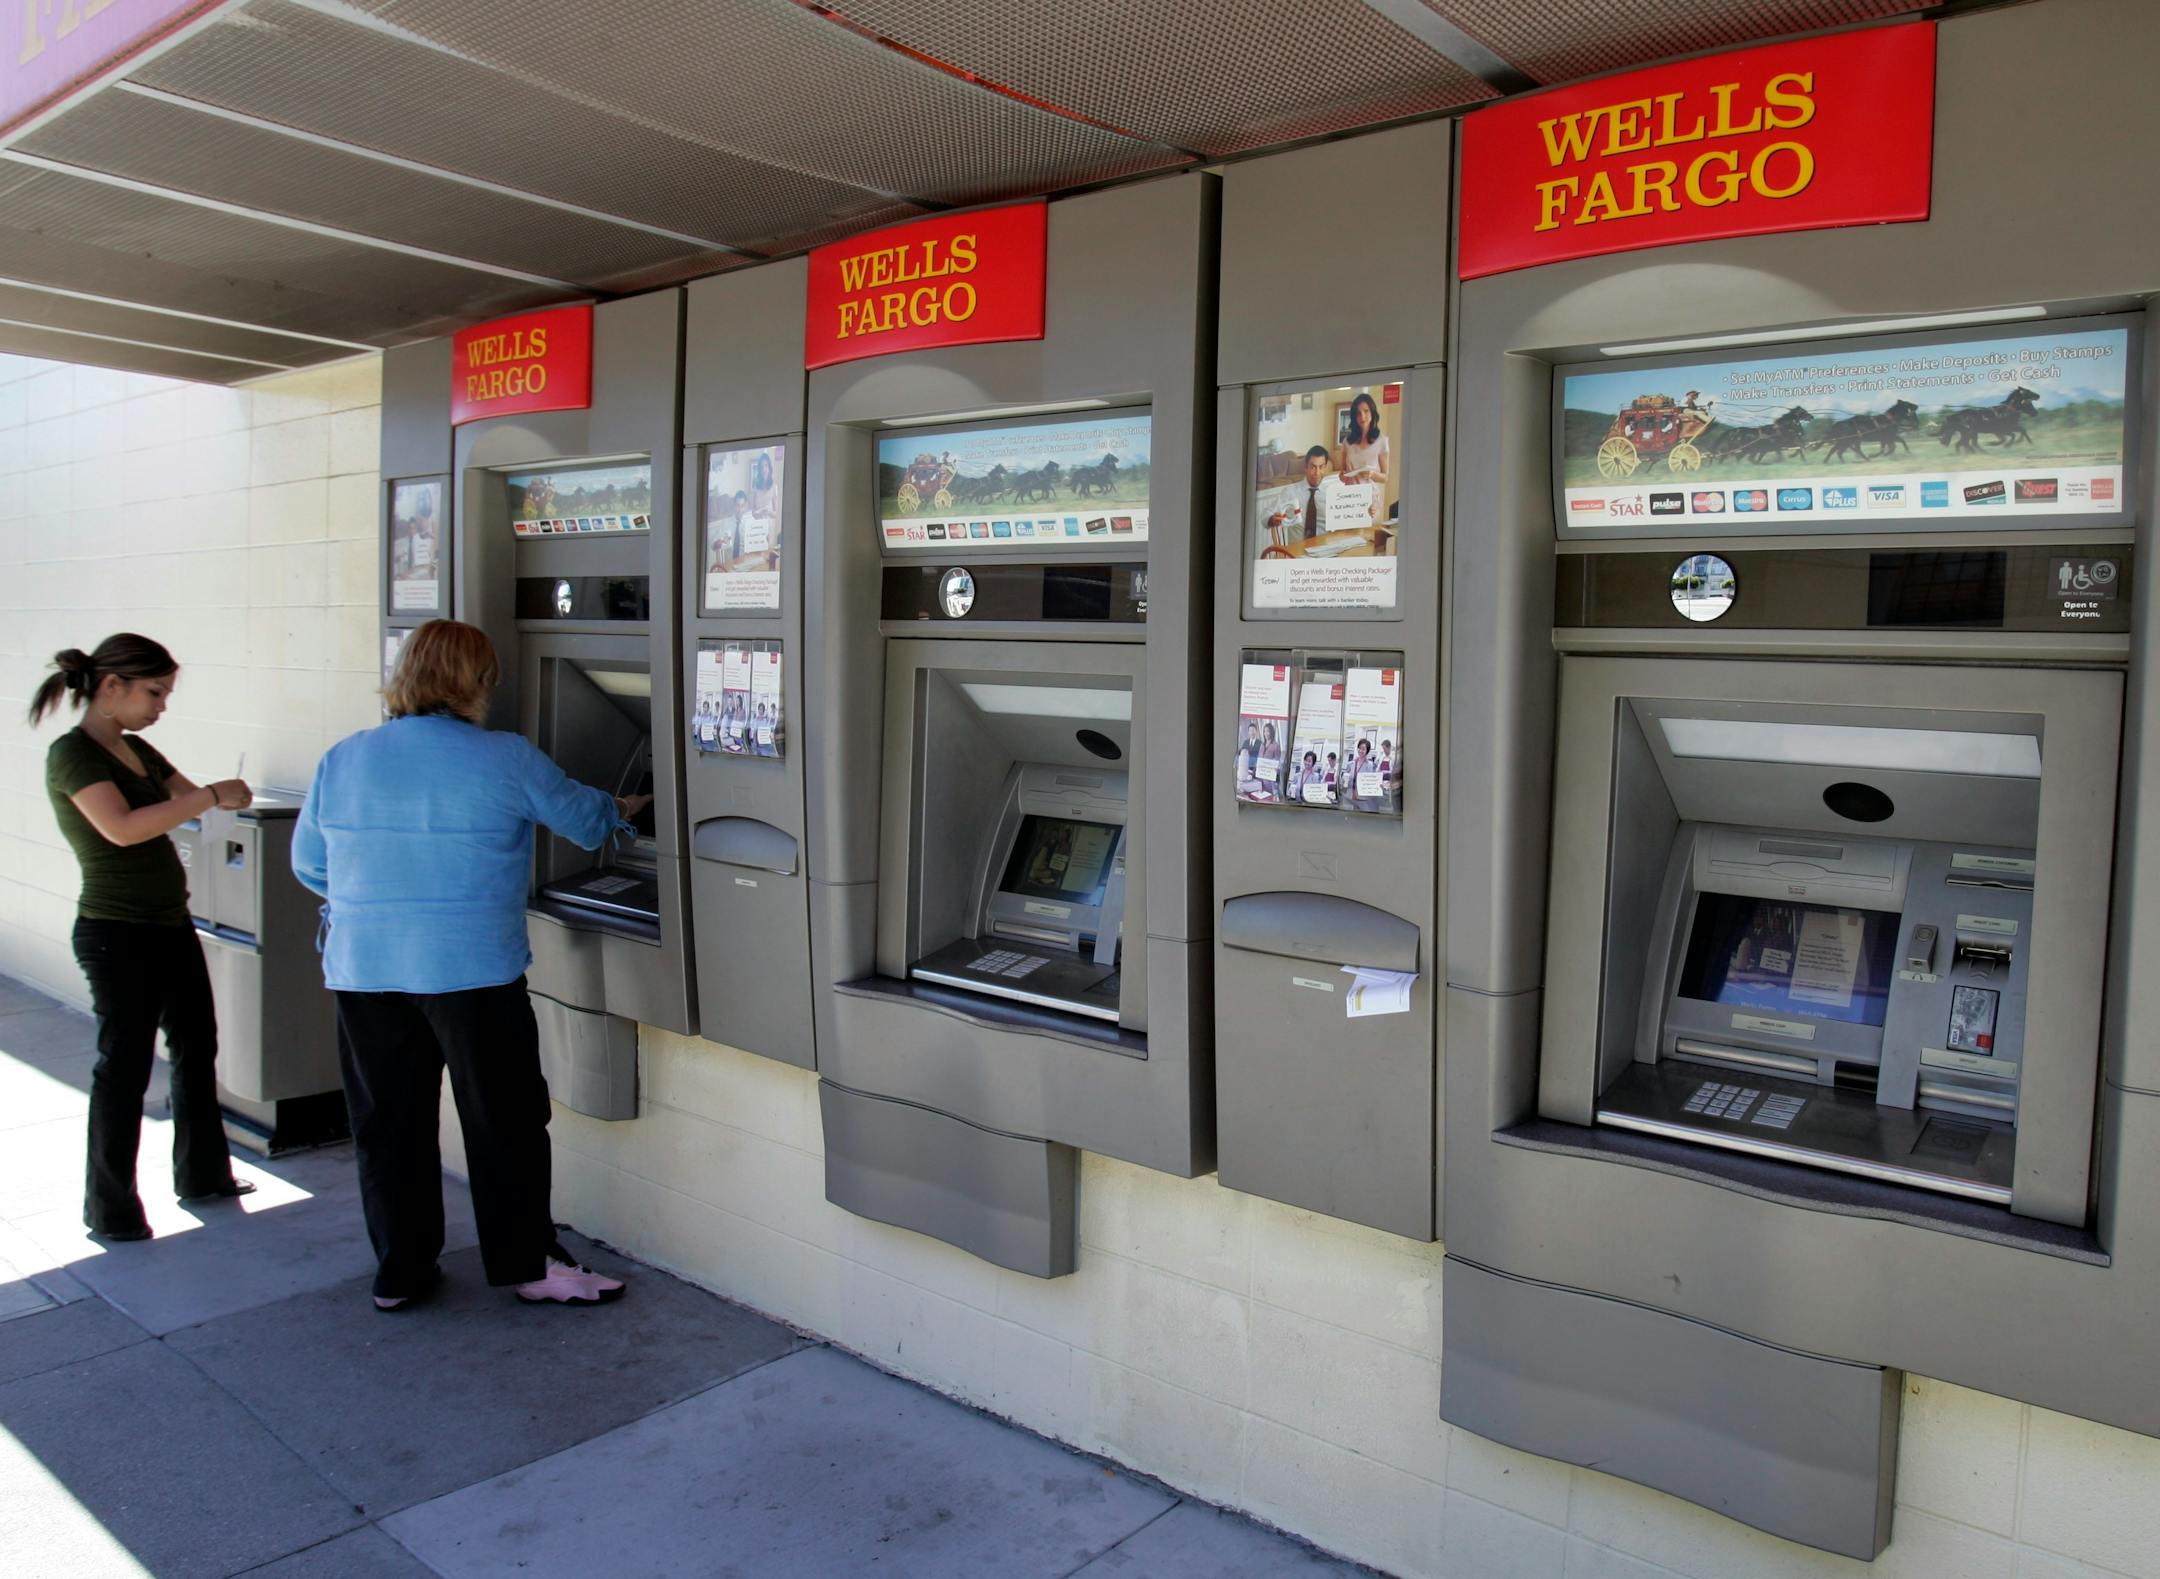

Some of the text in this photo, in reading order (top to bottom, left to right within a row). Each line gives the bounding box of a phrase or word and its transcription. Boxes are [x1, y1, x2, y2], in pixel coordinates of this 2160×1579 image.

[1538, 72, 1816, 167] WELLS
[1534, 141, 1815, 232] FARGO
[839, 234, 977, 293] WELLS
[837, 282, 977, 339] FARGO
[467, 328, 547, 368] WELLS
[1730, 373, 1751, 385] Set
[1809, 362, 1889, 378] Preferences
[1901, 358, 1939, 371] Make
[1942, 351, 2008, 369] Deposits
[2019, 350, 2049, 364] Buy
[2053, 344, 2113, 360] Stamps
[465, 364, 547, 403] FARGO
[1730, 365, 2060, 401] Make Transfers Print Statements Get Cash
[1652, 498, 1682, 510] pulse
[1833, 497, 1857, 506] PLUS
[1874, 492, 1900, 501] VISA
[1965, 484, 2005, 498] DISCOVER
[1610, 502, 1645, 517] STAR
[907, 532, 925, 540] STAR
[1290, 569, 1305, 577] Open
[1311, 568, 1324, 576] Wells
[1325, 568, 1340, 576] Fargo
[1342, 567, 1367, 576] Checking
